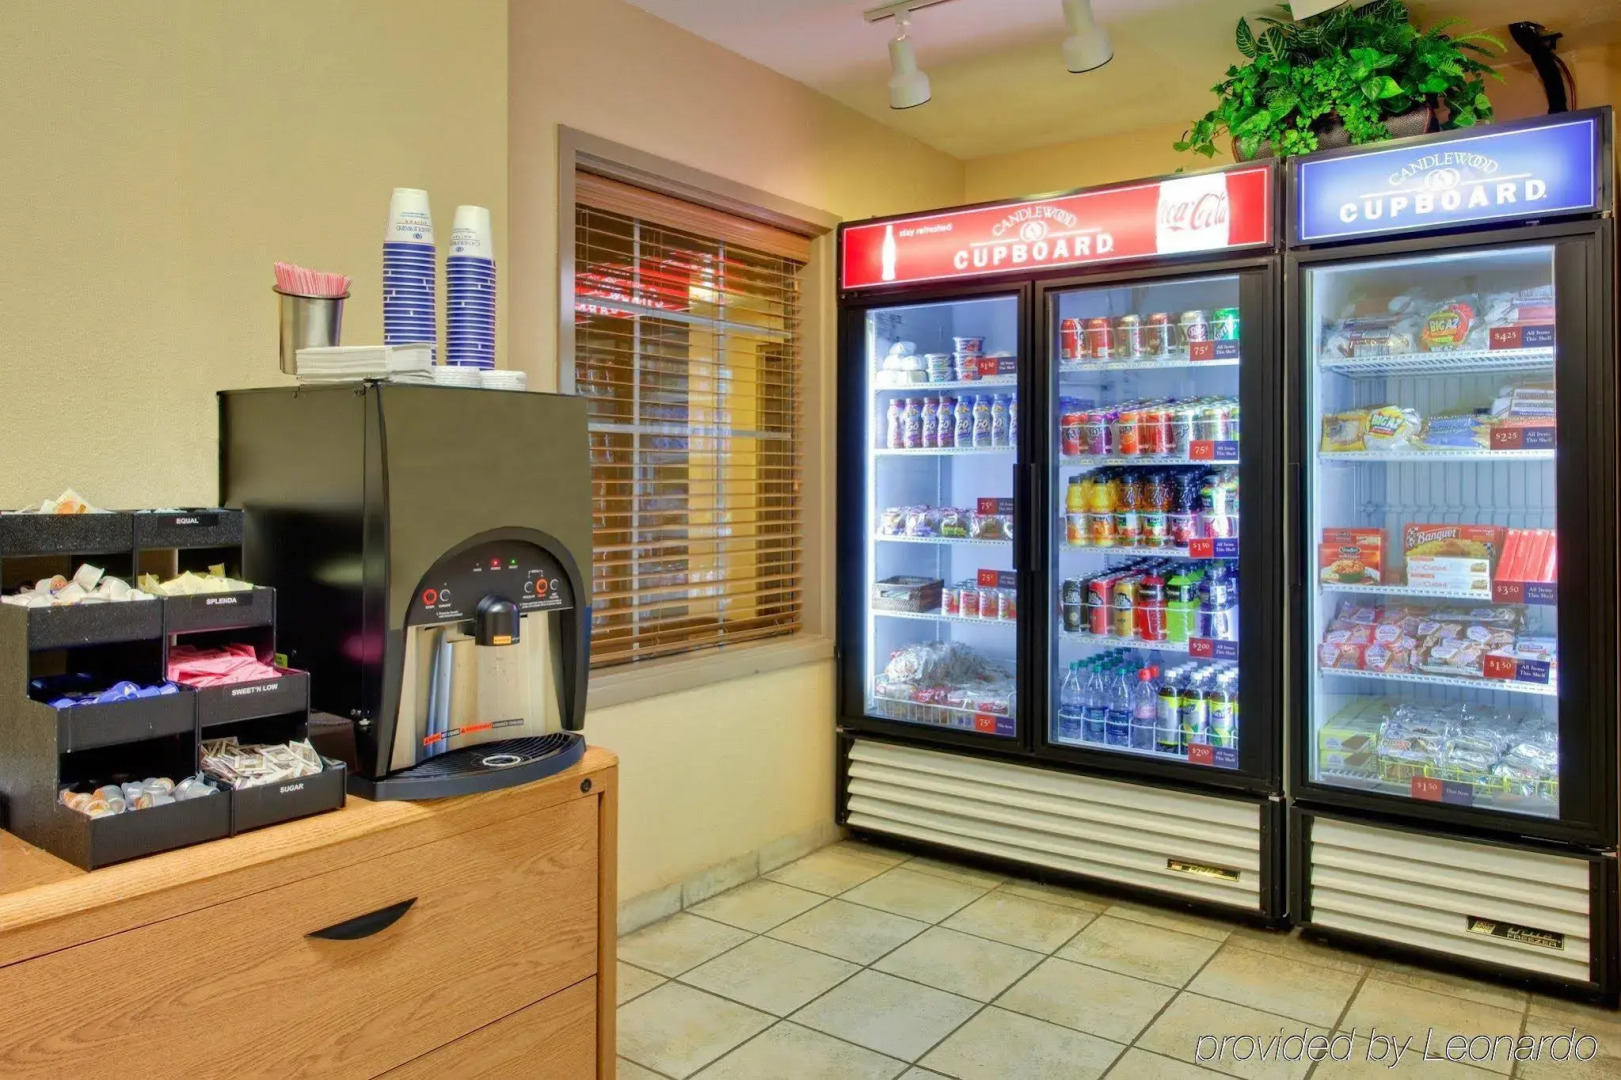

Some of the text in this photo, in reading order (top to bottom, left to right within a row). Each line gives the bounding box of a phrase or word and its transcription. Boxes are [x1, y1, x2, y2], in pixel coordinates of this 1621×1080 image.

[1388, 152, 1498, 186] CANDLEWOOD
[1339, 179, 1544, 223] CUPBOARD
[992, 205, 1077, 237] CANDLEWOOD
[953, 233, 1113, 270] CUPBOARD
[175, 517, 199, 525] EQUAL
[1416, 528, 1457, 545] Banquet
[205, 597, 237, 605] SPLENDA
[231, 683, 279, 696] SWEET'N LOW
[279, 783, 304, 793] SUGAR
